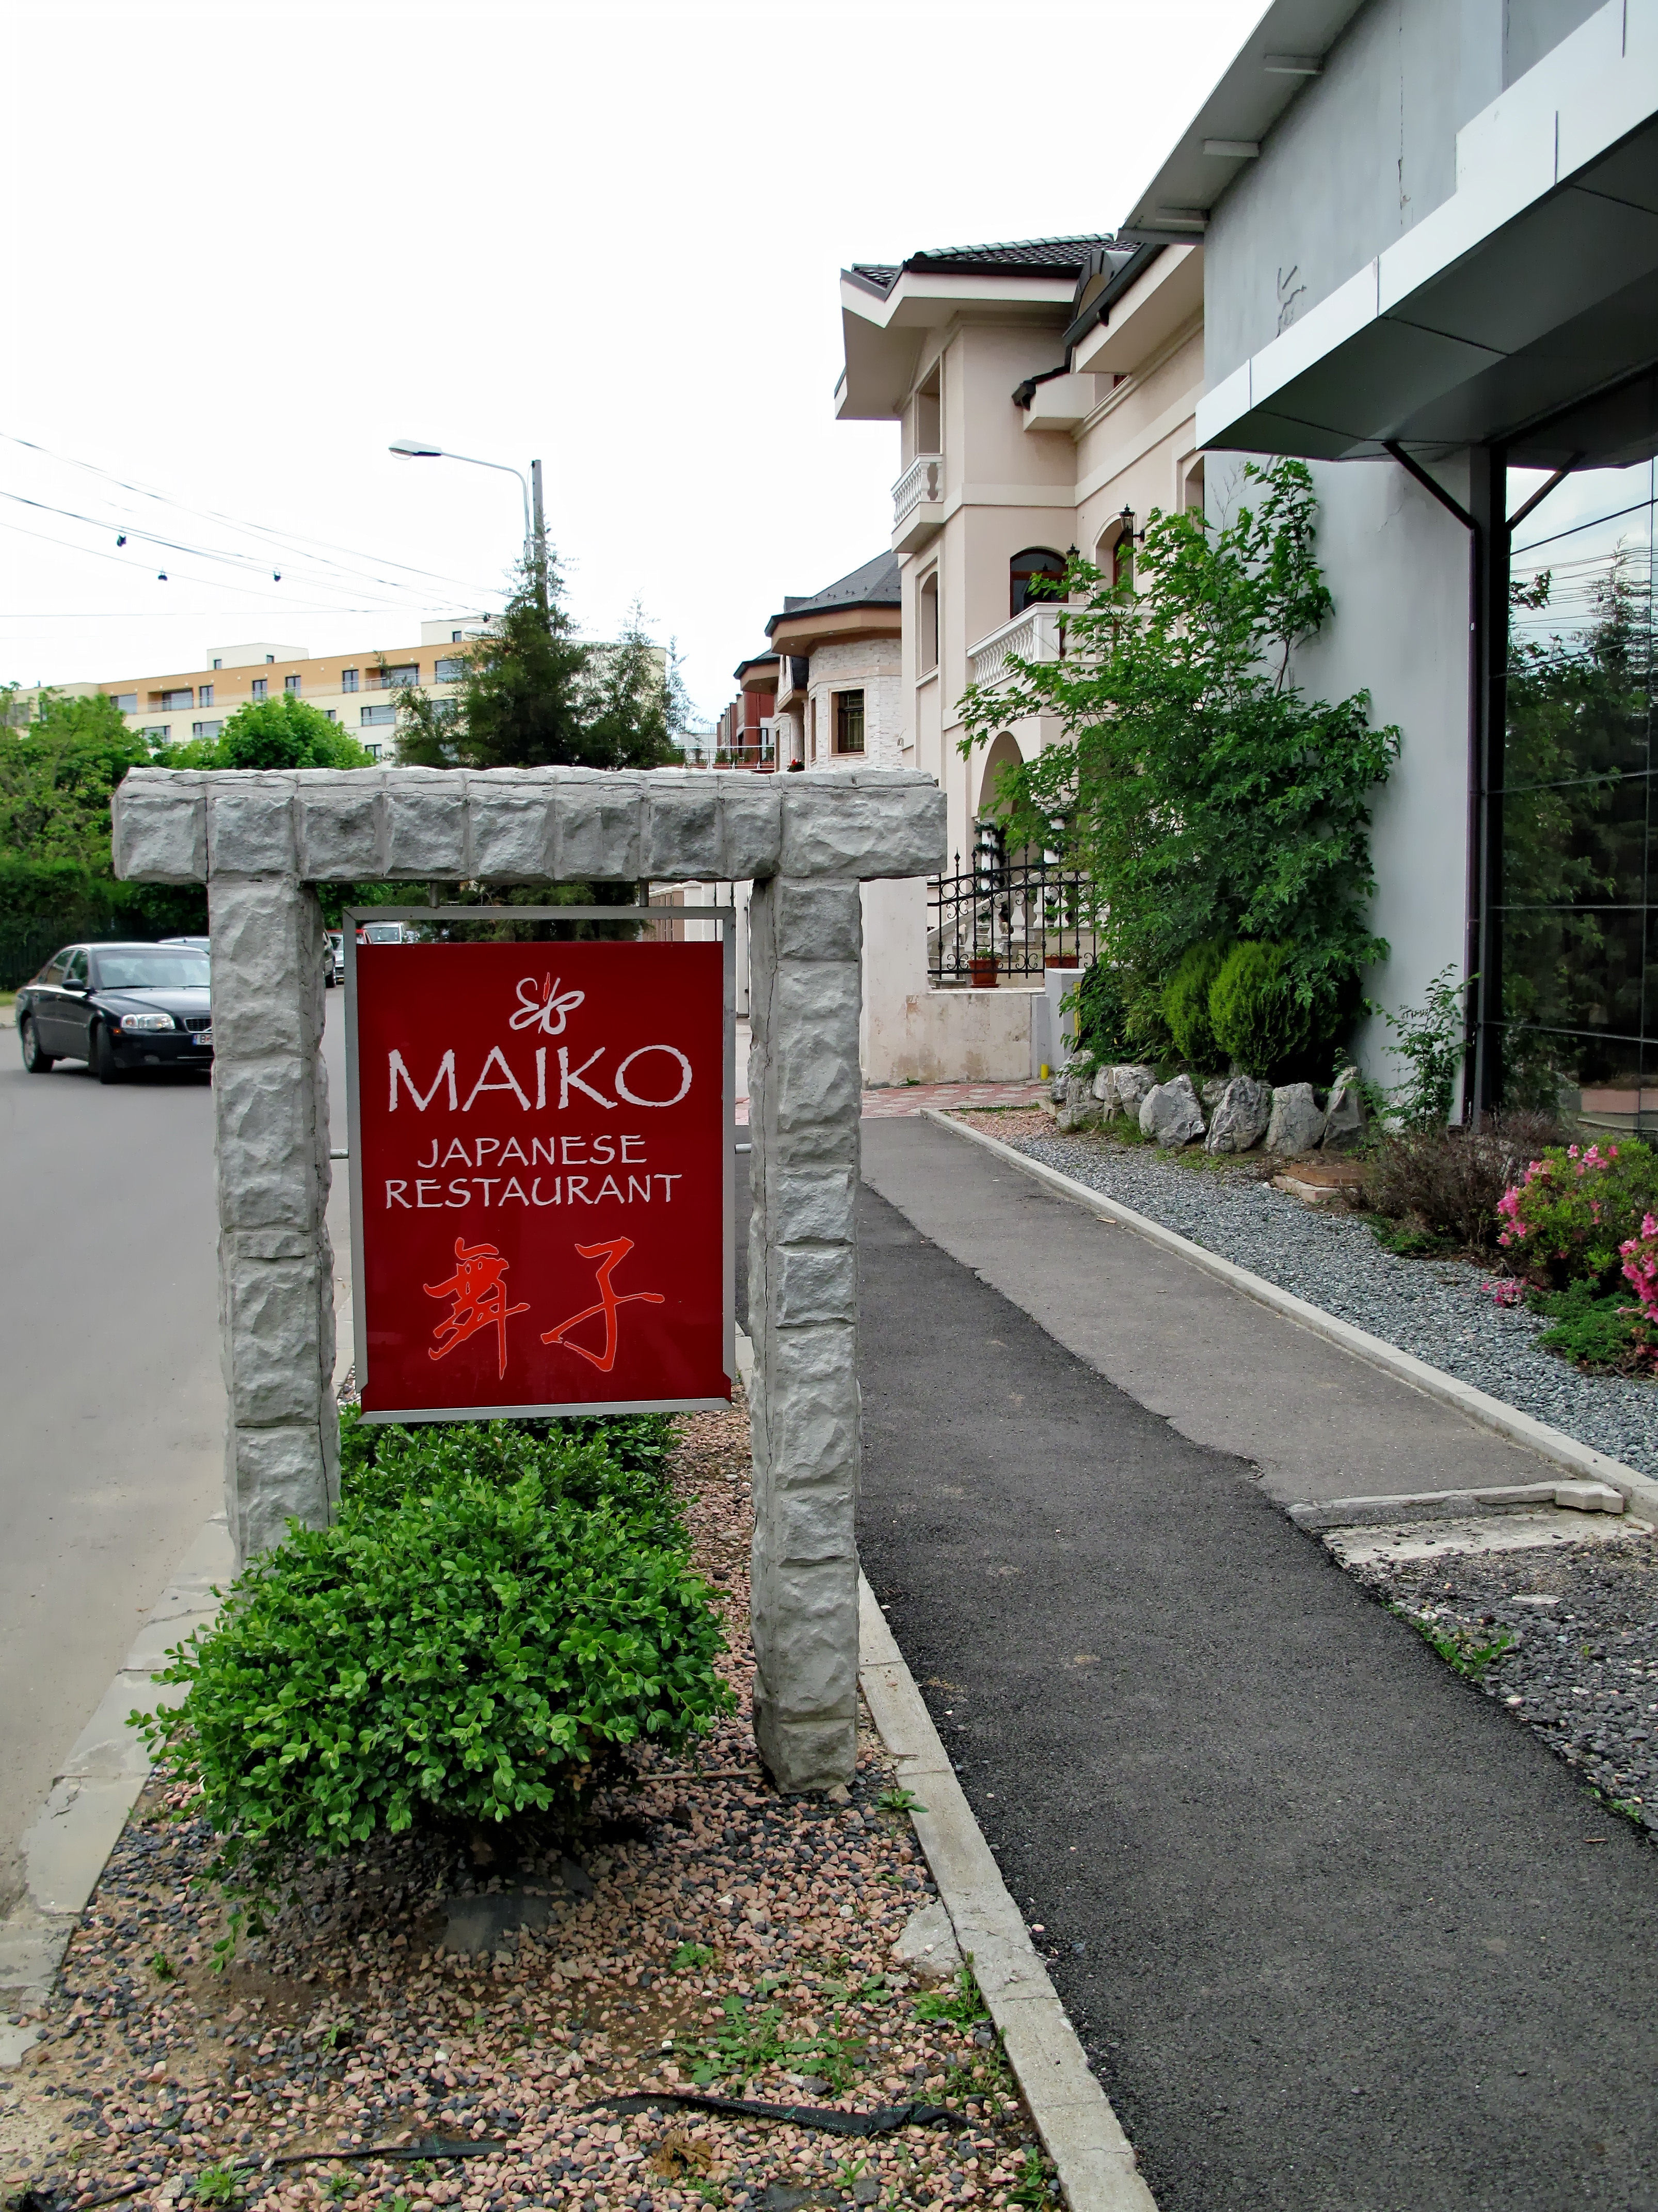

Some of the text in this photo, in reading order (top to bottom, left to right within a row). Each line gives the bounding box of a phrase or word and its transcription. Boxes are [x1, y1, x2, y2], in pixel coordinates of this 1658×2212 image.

[389, 1045, 693, 1112] MAIKO
[418, 1135, 647, 1168] JAPANESE
[386, 1174, 682, 1209] RESTAURANT
[423, 1237, 665, 1380] 舞子
